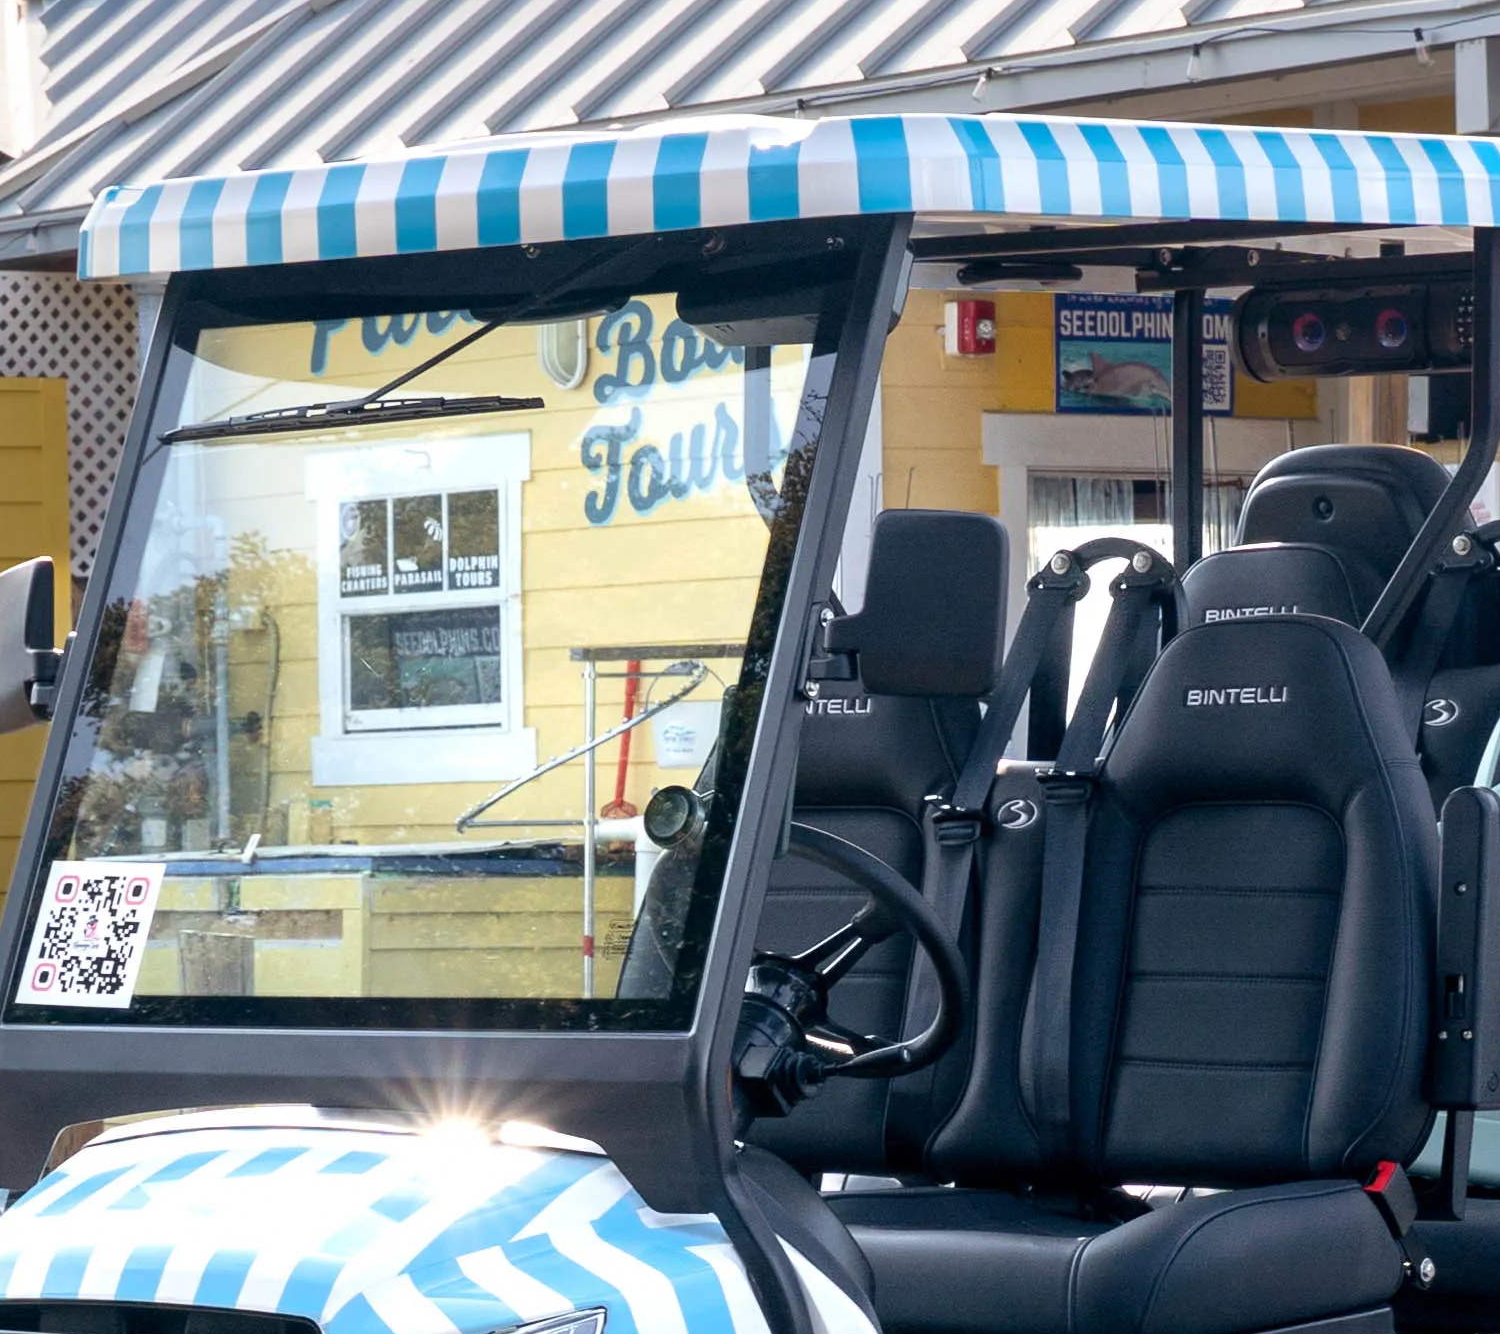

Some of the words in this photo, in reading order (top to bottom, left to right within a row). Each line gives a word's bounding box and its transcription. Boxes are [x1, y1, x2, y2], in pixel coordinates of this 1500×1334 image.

[450, 555, 498, 572] DOLPHIN
[342, 576, 387, 593] CHARTERS
[395, 570, 442, 586] PARASAIL
[456, 571, 493, 587] TOURS
[1186, 687, 1288, 706] BINTELLI
